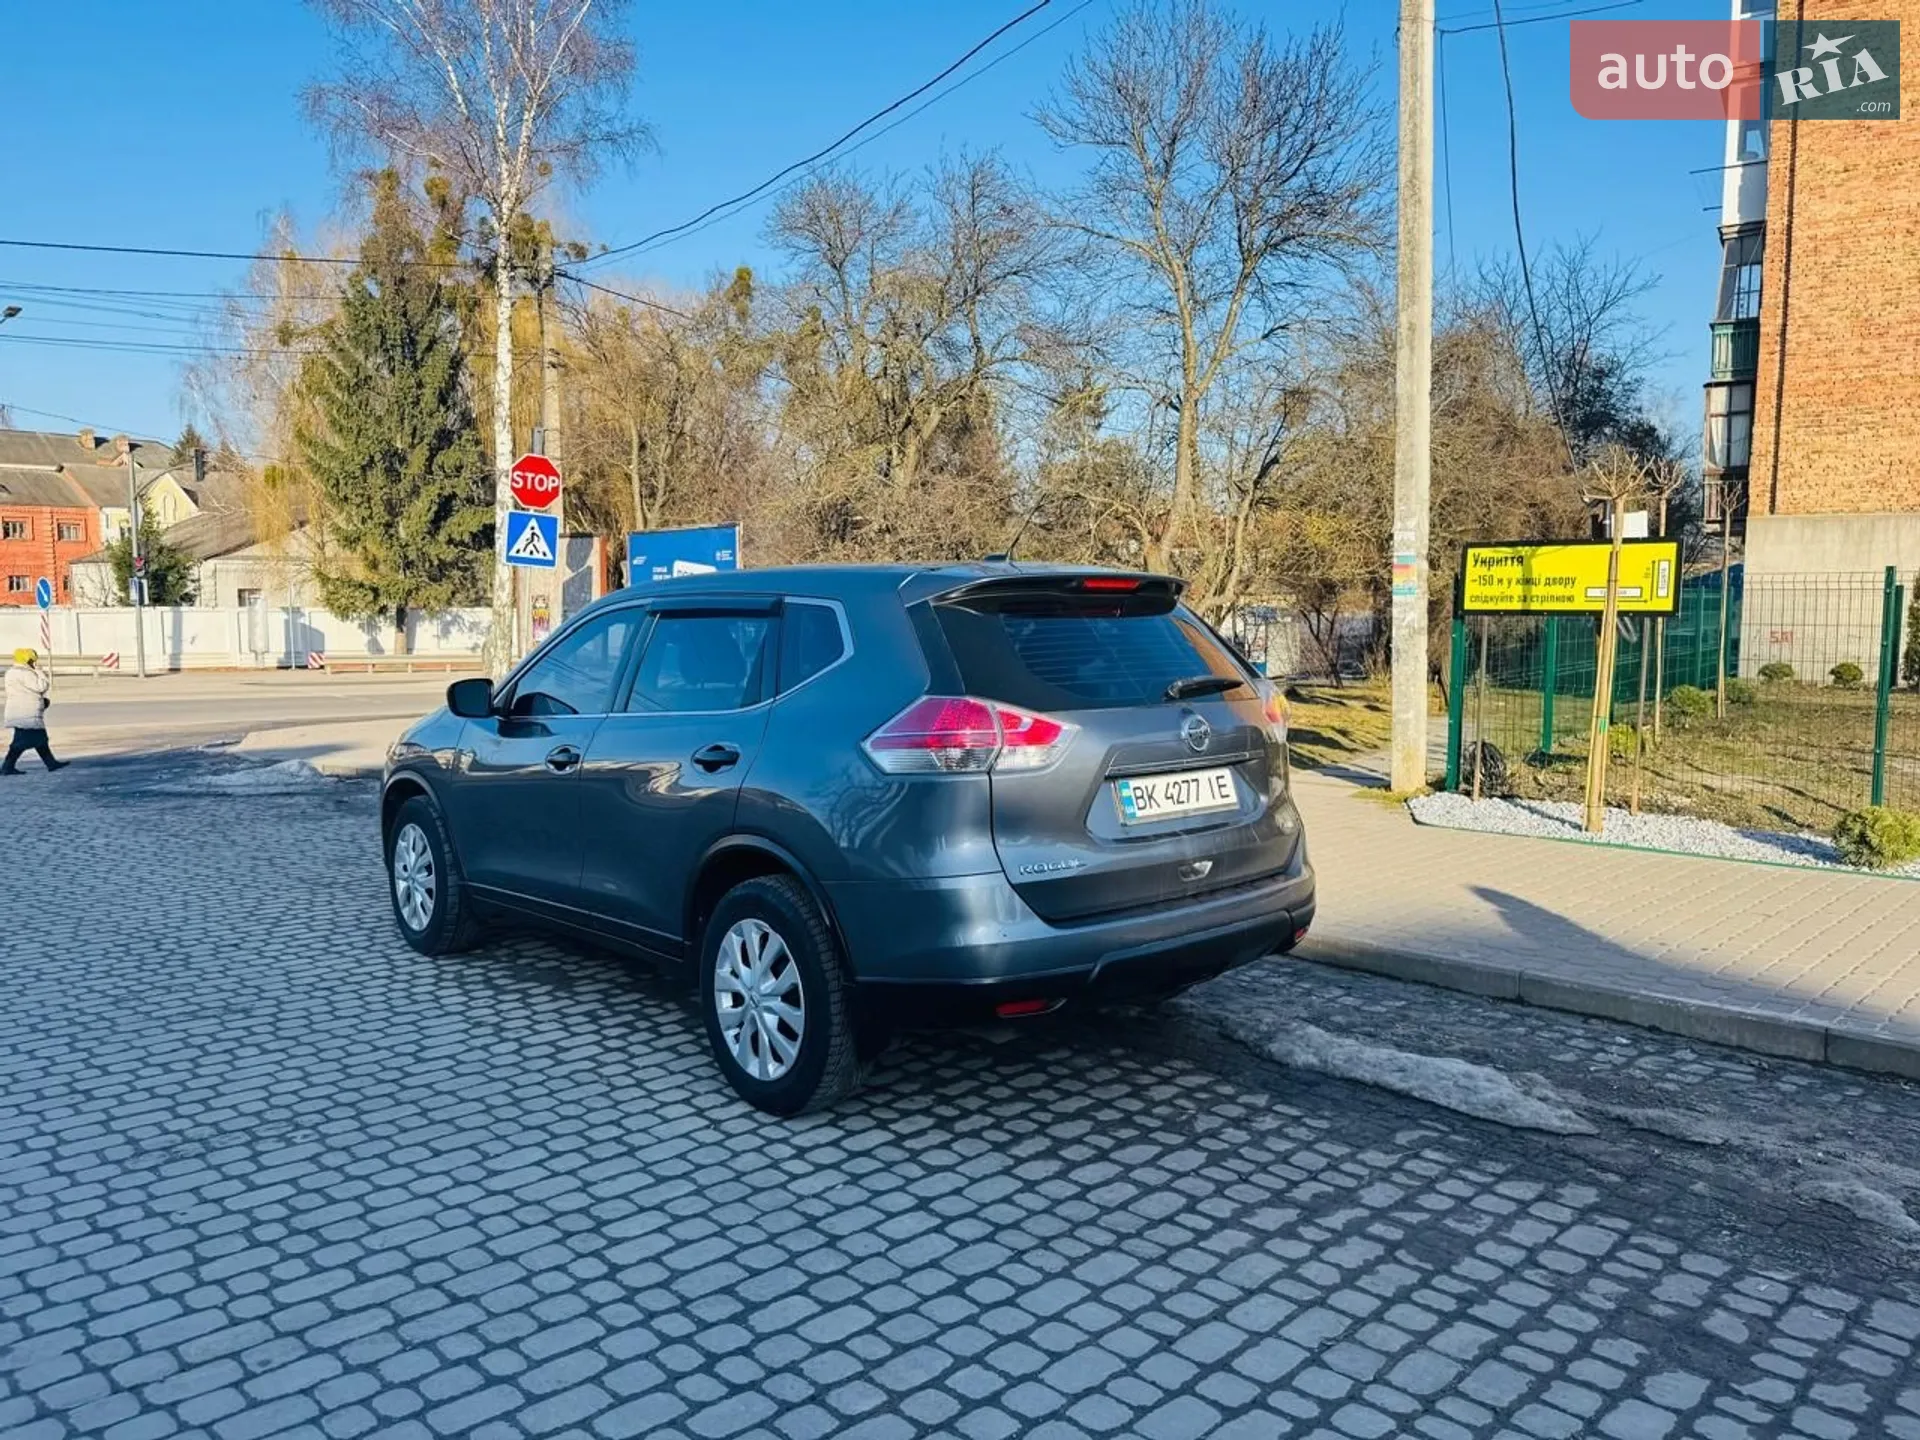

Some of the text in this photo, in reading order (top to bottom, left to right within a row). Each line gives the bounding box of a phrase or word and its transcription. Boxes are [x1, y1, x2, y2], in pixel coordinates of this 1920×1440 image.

[511, 470, 559, 492] STOP
[1472, 552, 1524, 571] Укриття
[1544, 575, 1577, 588] двору
[1133, 774, 1231, 811] BK 4277 IE
